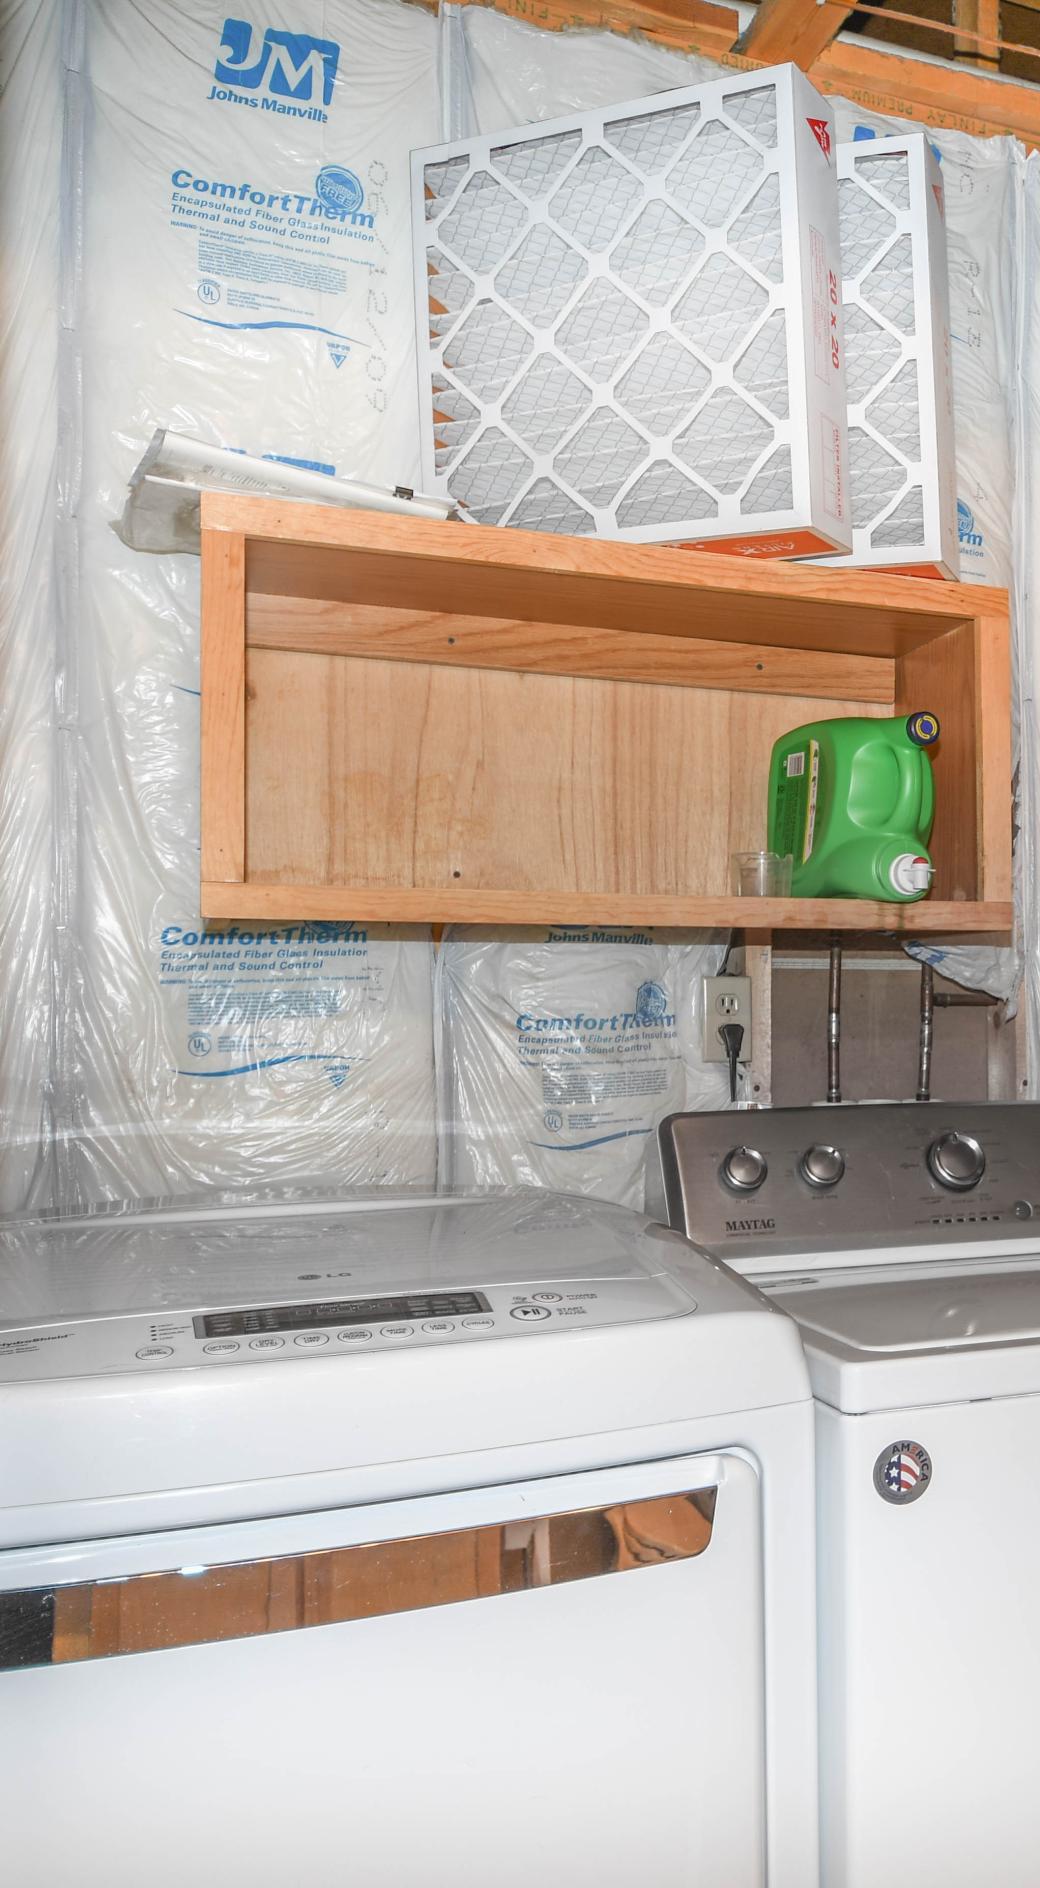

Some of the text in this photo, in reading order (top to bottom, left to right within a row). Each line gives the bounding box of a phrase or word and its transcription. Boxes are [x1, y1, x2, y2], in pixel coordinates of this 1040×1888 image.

[214, 18, 340, 106] JM
[206, 85, 329, 124] Johns Manville
[171, 169, 374, 229] ComfortTherm
[171, 192, 251, 216] Encapsulated
[255, 209, 284, 224] Fiber
[319, 222, 374, 243] Insulation
[171, 204, 220, 223] Thermal
[223, 215, 245, 228] and
[250, 220, 286, 236] Sound
[161, 926, 367, 946] ComfortTherm
[545, 931, 653, 946] Johns Manville
[244, 949, 272, 960] Fiber
[277, 949, 308, 959] Glass
[213, 961, 235, 972] and
[238, 960, 275, 971] Sound
[279, 958, 323, 970] Control
[516, 1012, 676, 1032] ComfortTherm
[618, 1042, 651, 1053] Control
[725, 1218, 776, 1231] MAYTAG
[892, 1443, 929, 1482] AMERICA
